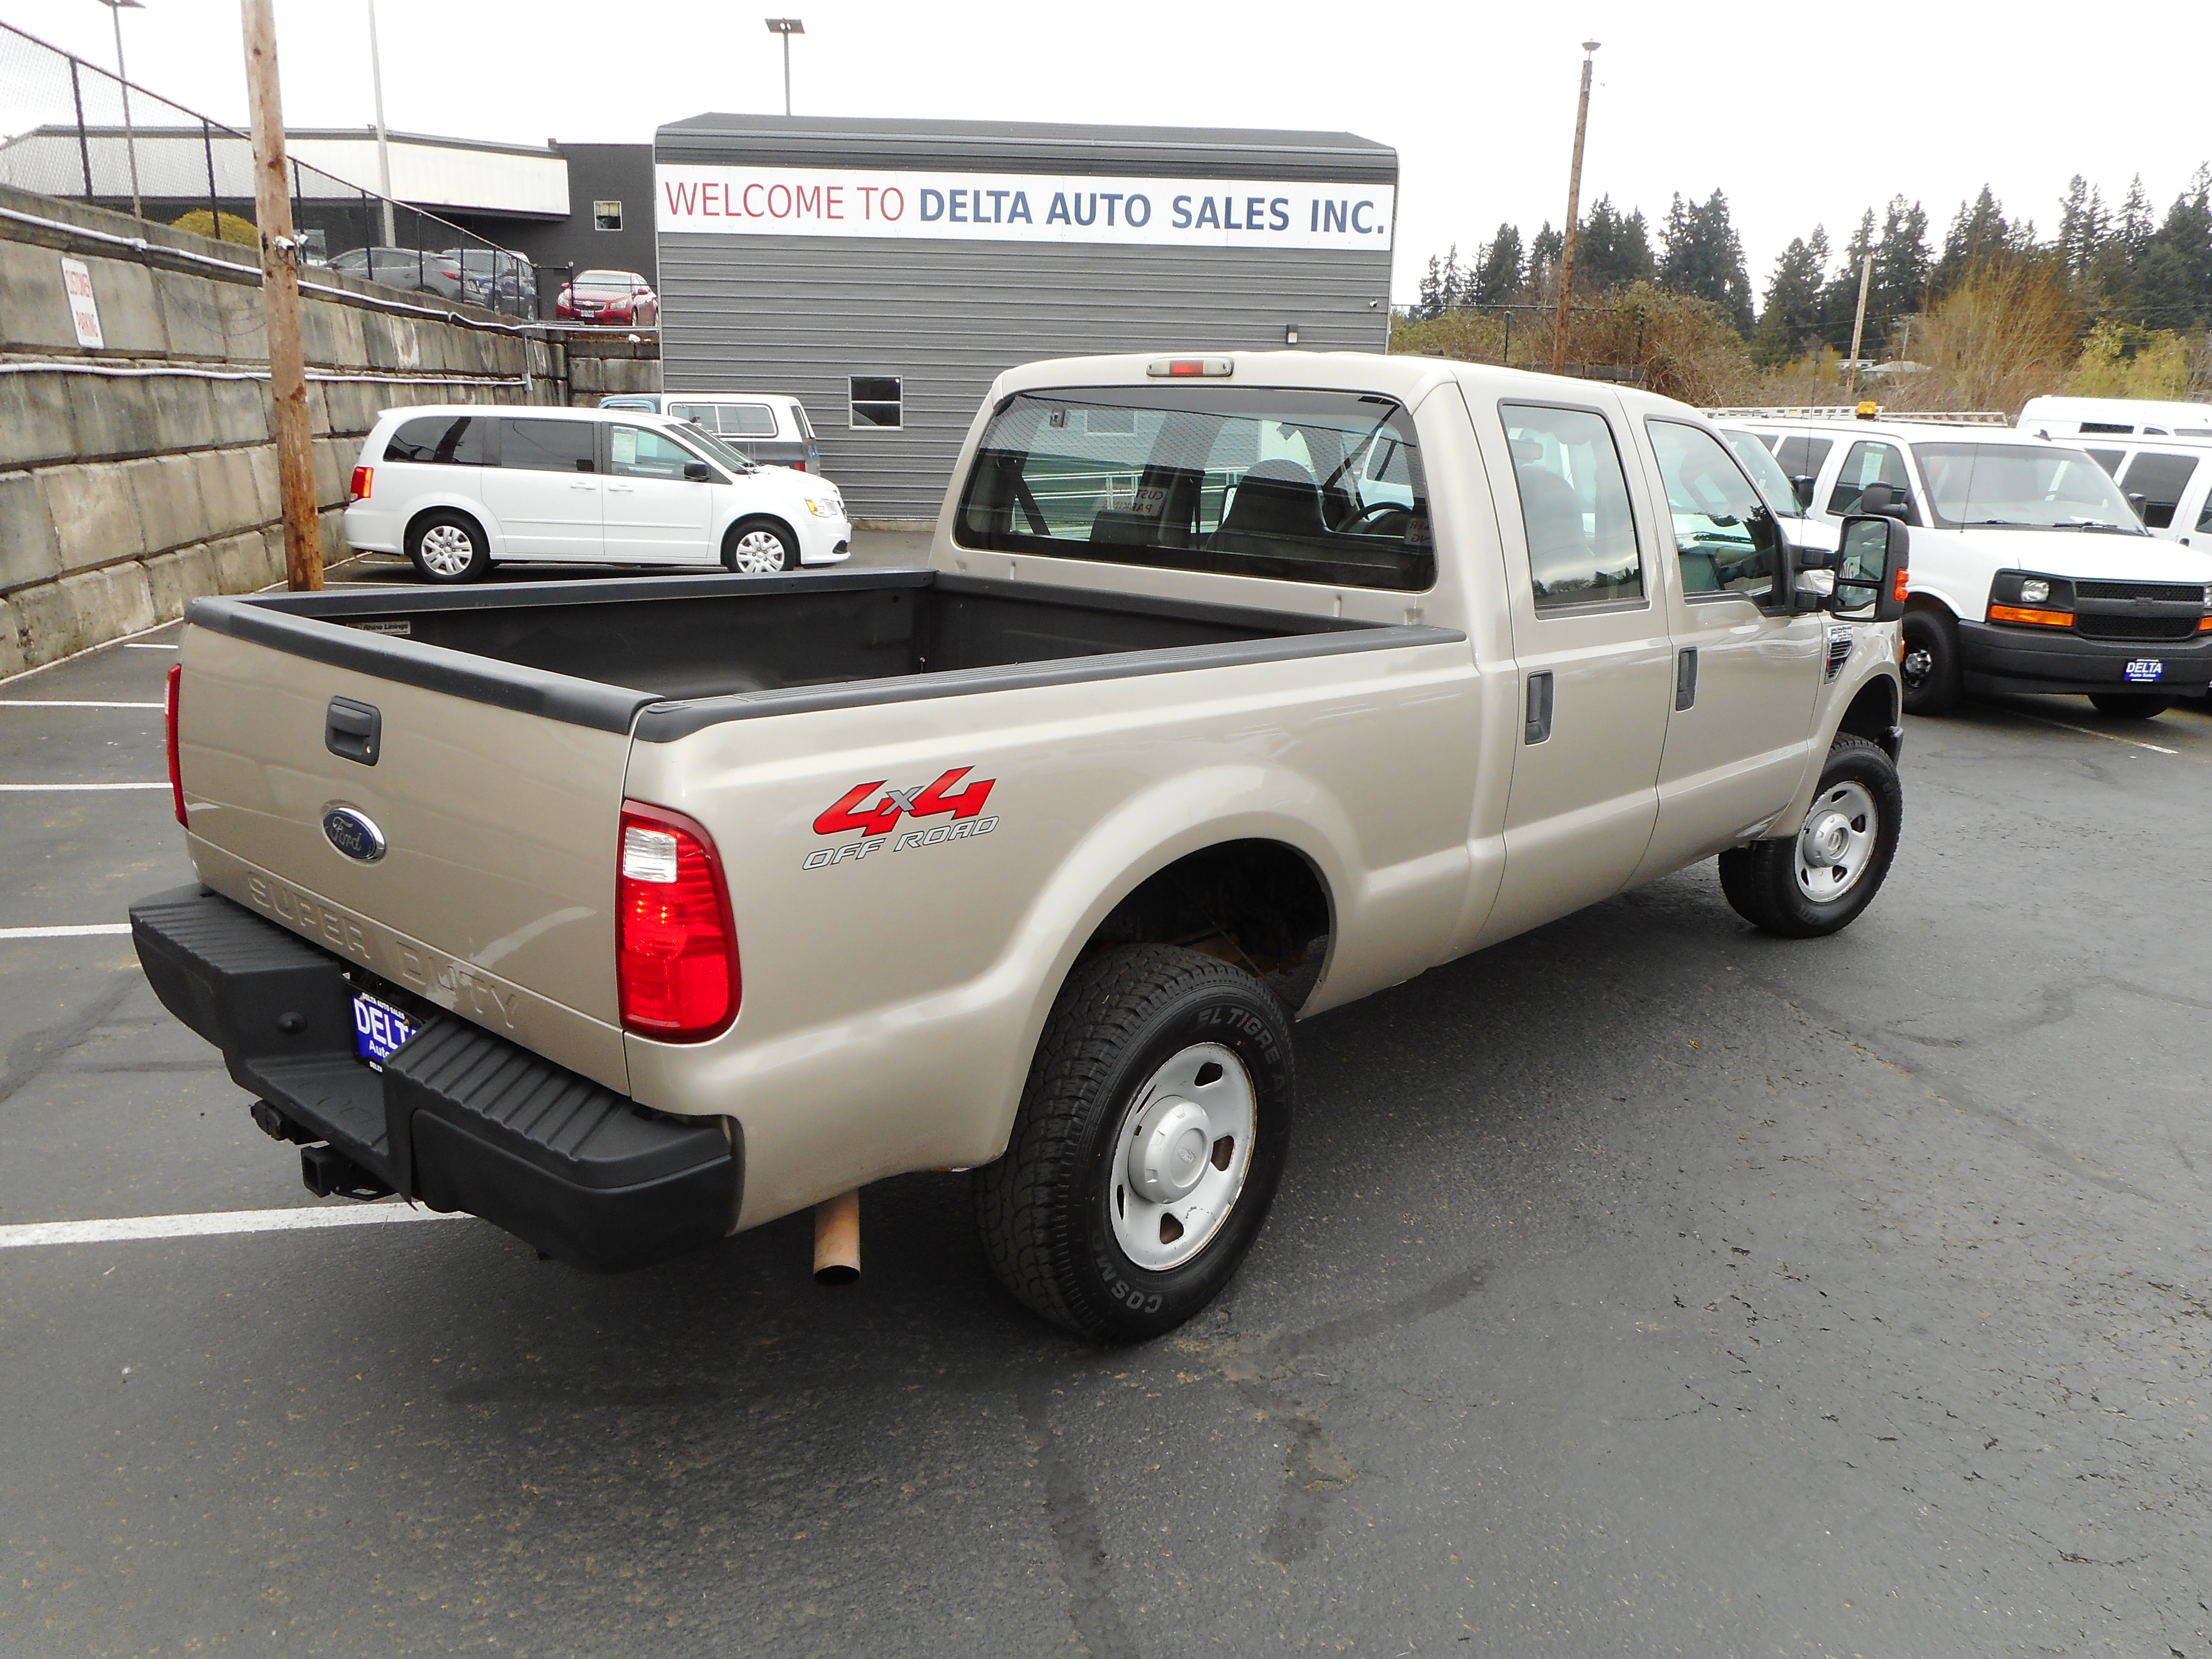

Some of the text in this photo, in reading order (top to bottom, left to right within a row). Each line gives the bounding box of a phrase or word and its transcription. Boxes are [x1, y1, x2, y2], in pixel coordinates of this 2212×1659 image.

[665, 181, 1385, 234] WELCOME TO DELTA AUTO SALES INC.
[2126, 662, 2162, 673] DELTA
[331, 816, 363, 852] Ford
[802, 816, 1000, 871] OFF ROAD
[247, 871, 518, 1029] SUPER DUTY
[354, 998, 416, 1050] DELT
[362, 992, 405, 1021] DELTA AUTO SALES
[1197, 1007, 1222, 1025] EL
[1227, 1007, 1281, 1065] TIGRE
[1091, 1230, 1163, 1314] COSMO
